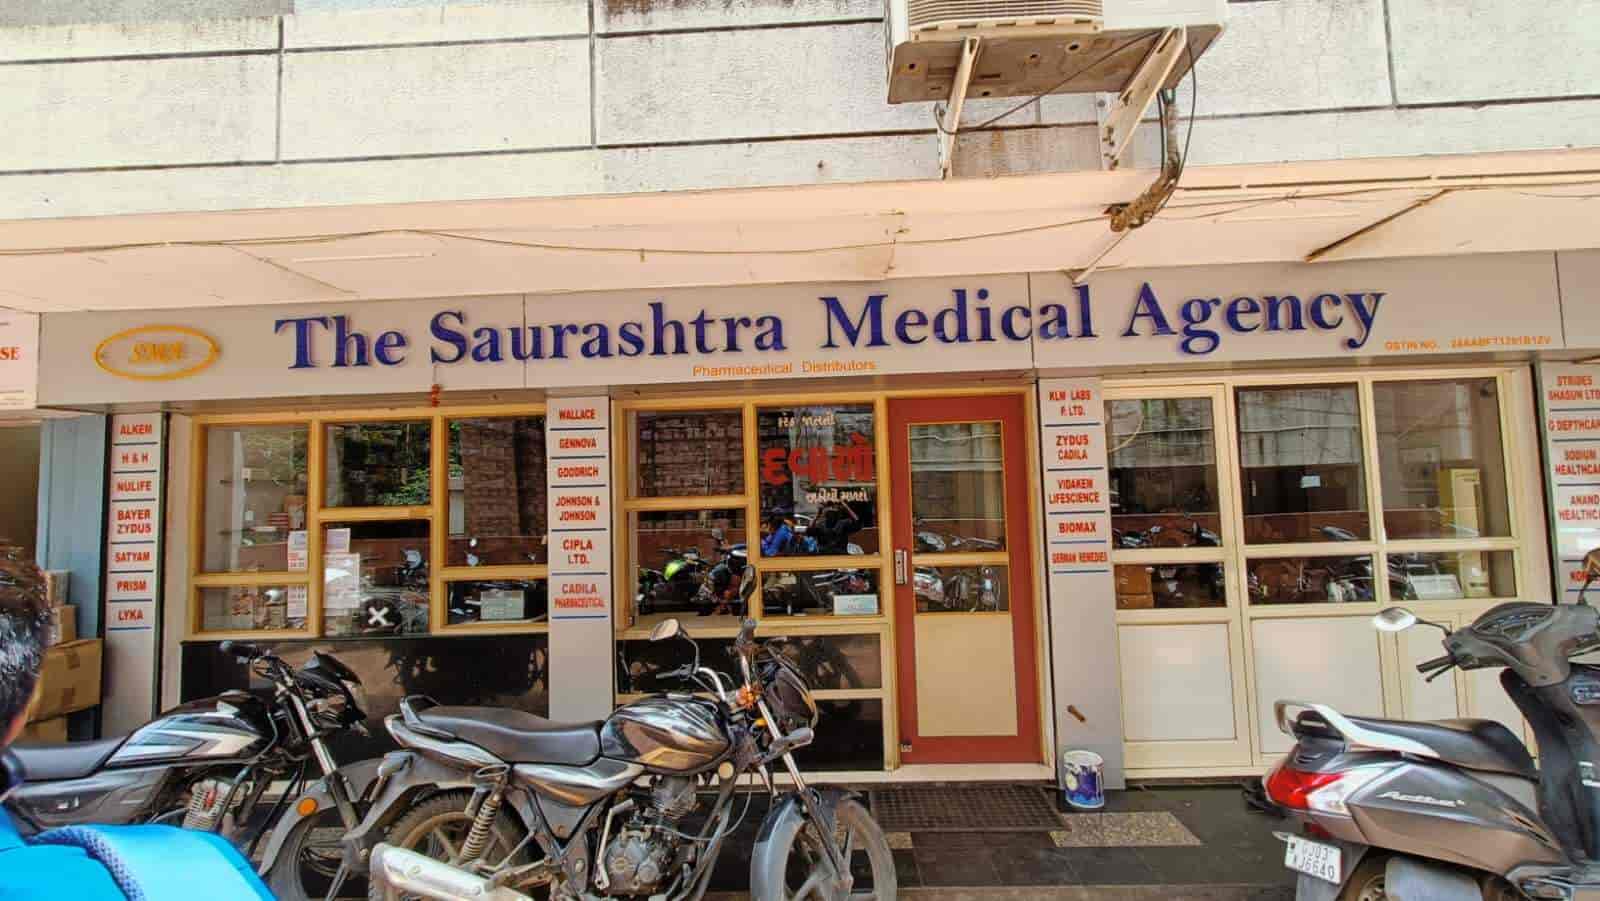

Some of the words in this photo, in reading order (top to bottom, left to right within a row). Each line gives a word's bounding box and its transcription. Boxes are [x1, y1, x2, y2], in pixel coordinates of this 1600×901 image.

[274, 315, 407, 369] The
[431, 302, 786, 364] Saurashtra
[819, 283, 1096, 348] Medical
[1121, 282, 1387, 356] Agency
[692, 361, 793, 377] Pharmaceutical
[800, 359, 877, 373] Distributors
[1557, 375, 1593, 387] STRIDES
[1049, 390, 1066, 401] KLM
[1070, 389, 1092, 400] LABS
[559, 409, 596, 421] WALLACE
[1068, 405, 1086, 416] LTD.
[120, 423, 153, 436] ALKEM
[559, 438, 597, 449] GENNOVA
[1056, 434, 1089, 446] ZYDUS
[122, 453, 129, 465] H
[132, 453, 139, 464] &
[141, 452, 149, 464] H
[763, 432, 873, 485] દવાઓ
[1058, 449, 1088, 460] CADILA
[557, 465, 599, 478] GOODRICH
[116, 480, 152, 493] NULIFE
[1058, 478, 1094, 490] VIDAKEM
[555, 495, 592, 507] JOHNSON
[594, 495, 600, 506] &
[1049, 492, 1100, 504] LIFESCIENCE
[1570, 494, 1600, 506] ANAND
[117, 509, 151, 521] BAYER
[559, 510, 596, 521] JOHNSON
[1559, 508, 1600, 521] HEALTHC
[117, 522, 152, 535] ZYDUS
[1059, 521, 1097, 534] BIOMAX
[563, 539, 593, 551] CIPLA
[115, 550, 150, 563] SATYAM
[568, 554, 590, 565] LTD.
[1052, 552, 1077, 564] GERMAN
[1078, 551, 1109, 563] REMEDIES
[116, 579, 147, 592] PRISM
[562, 583, 597, 594] CADILA
[554, 597, 605, 609] PHARMACEUTICAL
[117, 608, 144, 621] LYKA
